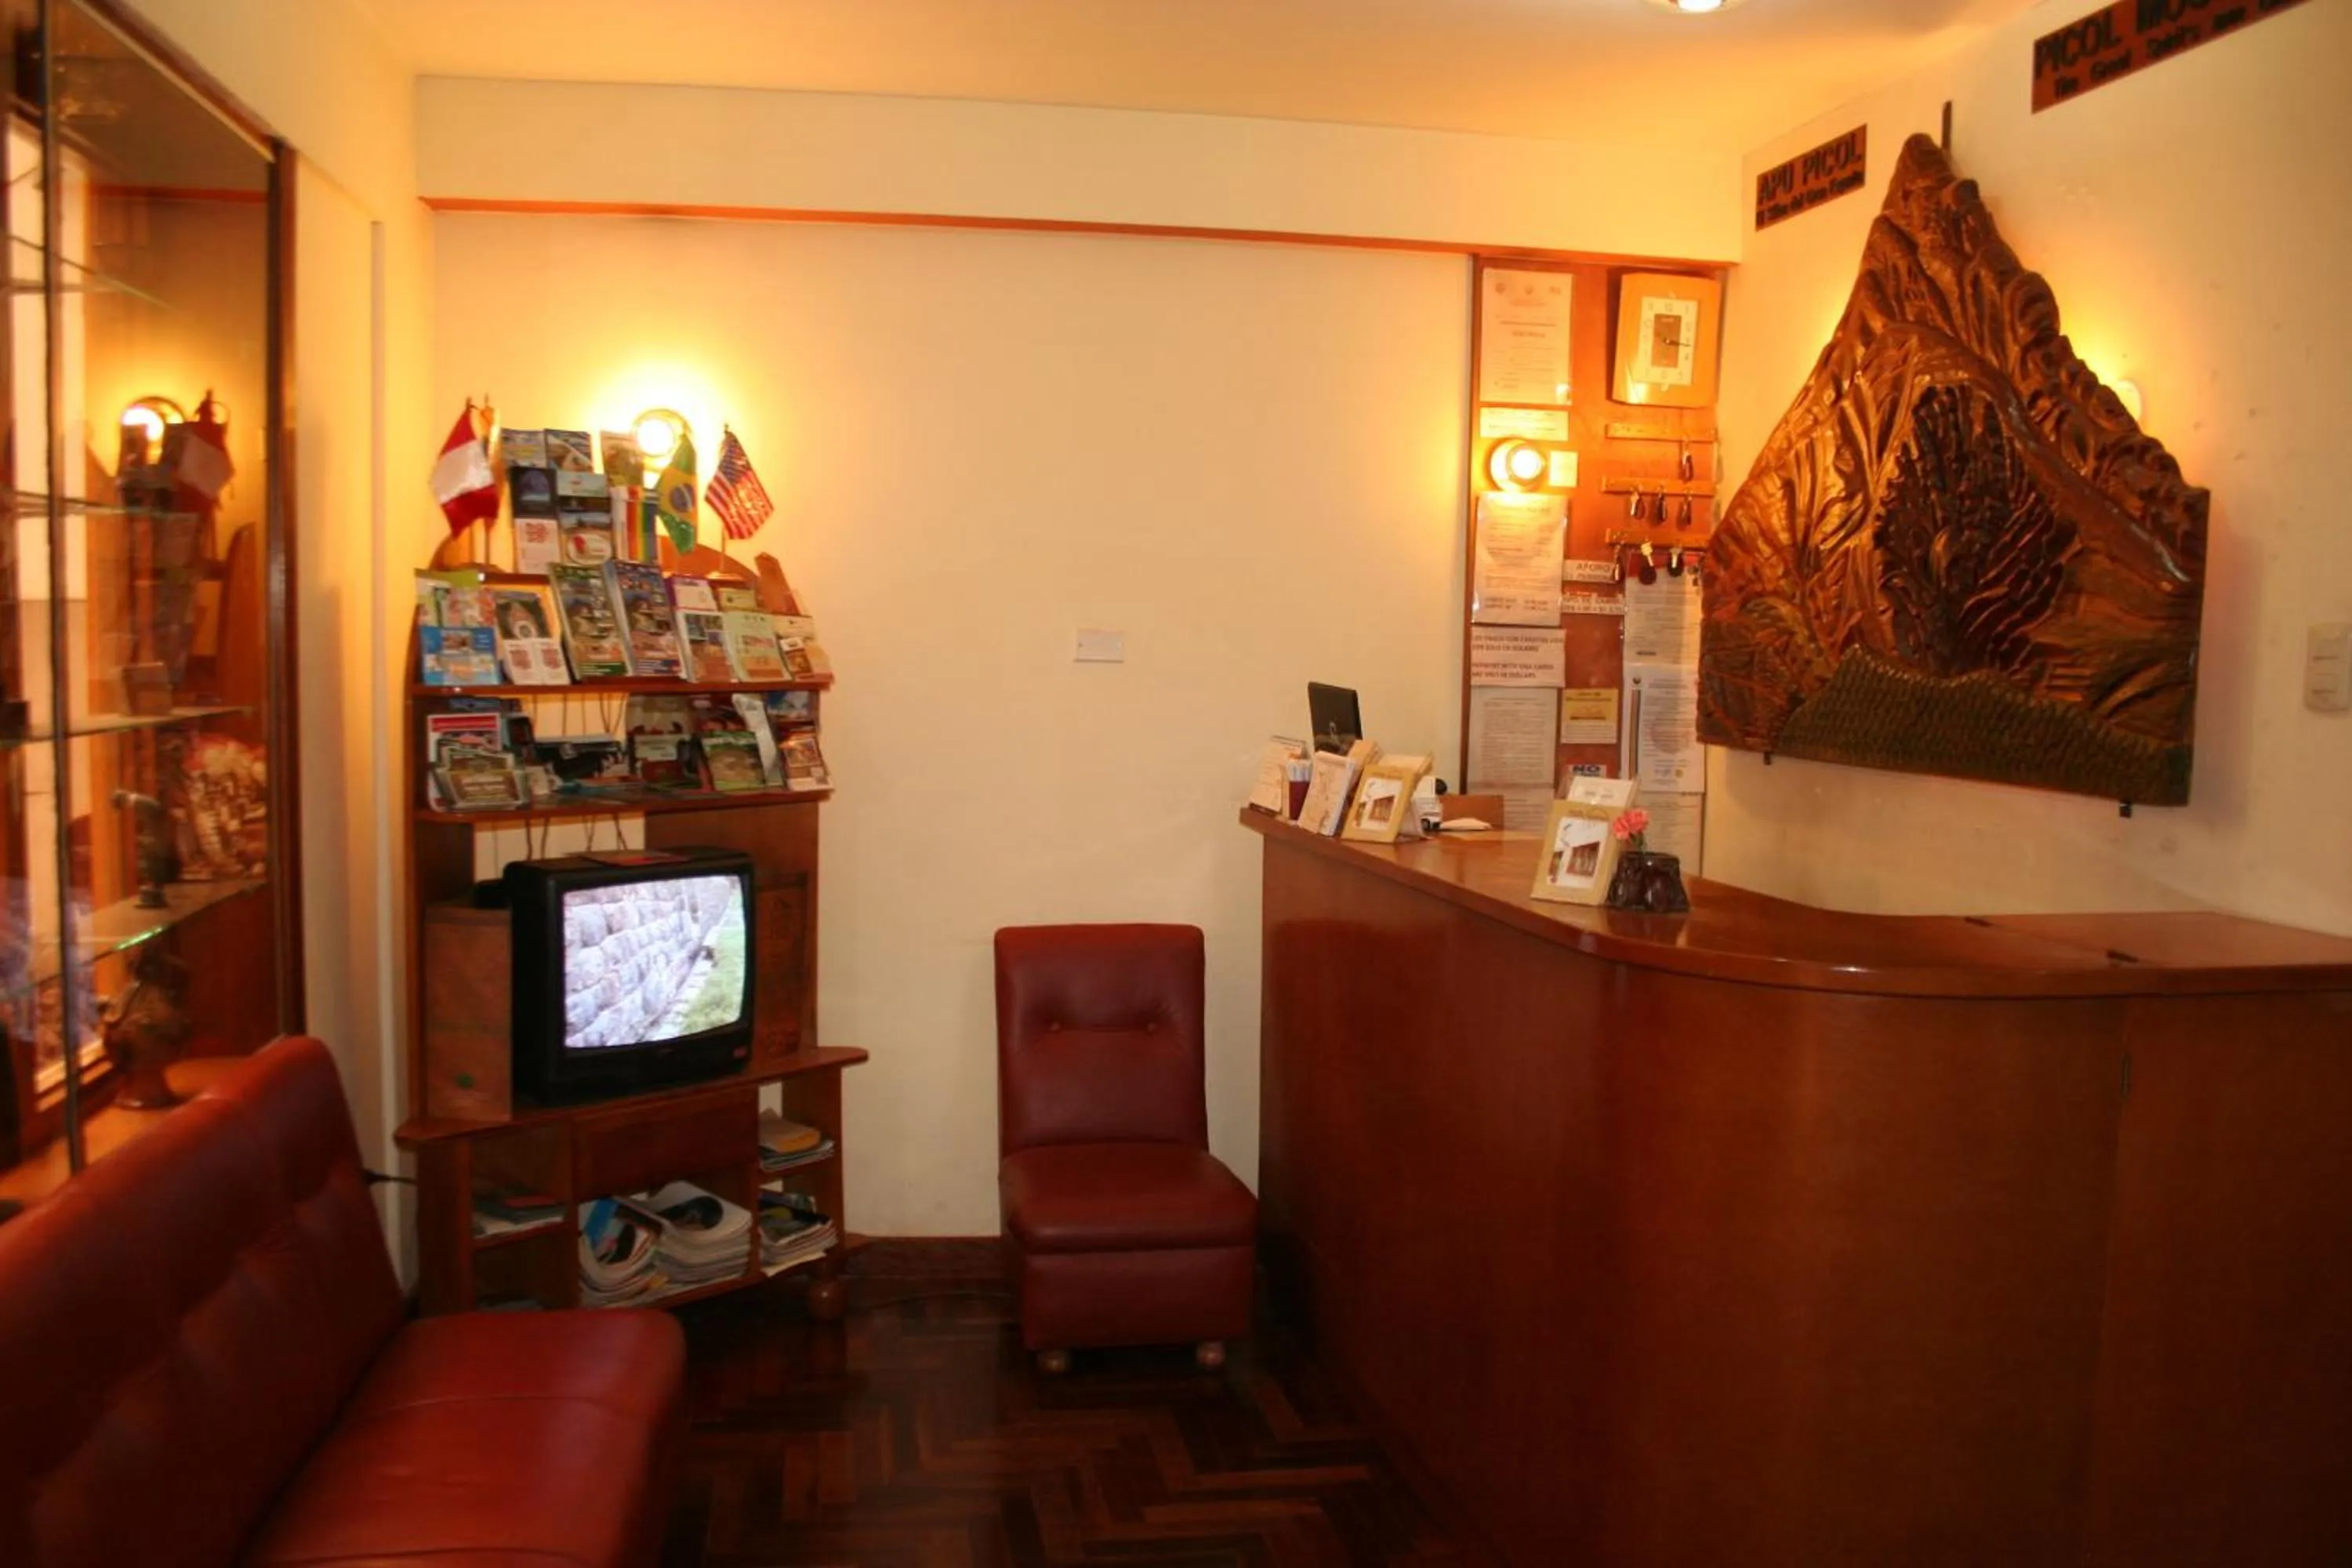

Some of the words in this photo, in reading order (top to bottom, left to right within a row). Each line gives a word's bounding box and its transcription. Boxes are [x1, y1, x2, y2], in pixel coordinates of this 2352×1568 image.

[2034, 9, 2121, 79] PICOL
[1759, 162, 1795, 205] APU
[1802, 132, 1863, 186] PICOL
[1577, 562, 1610, 573] AFORO
